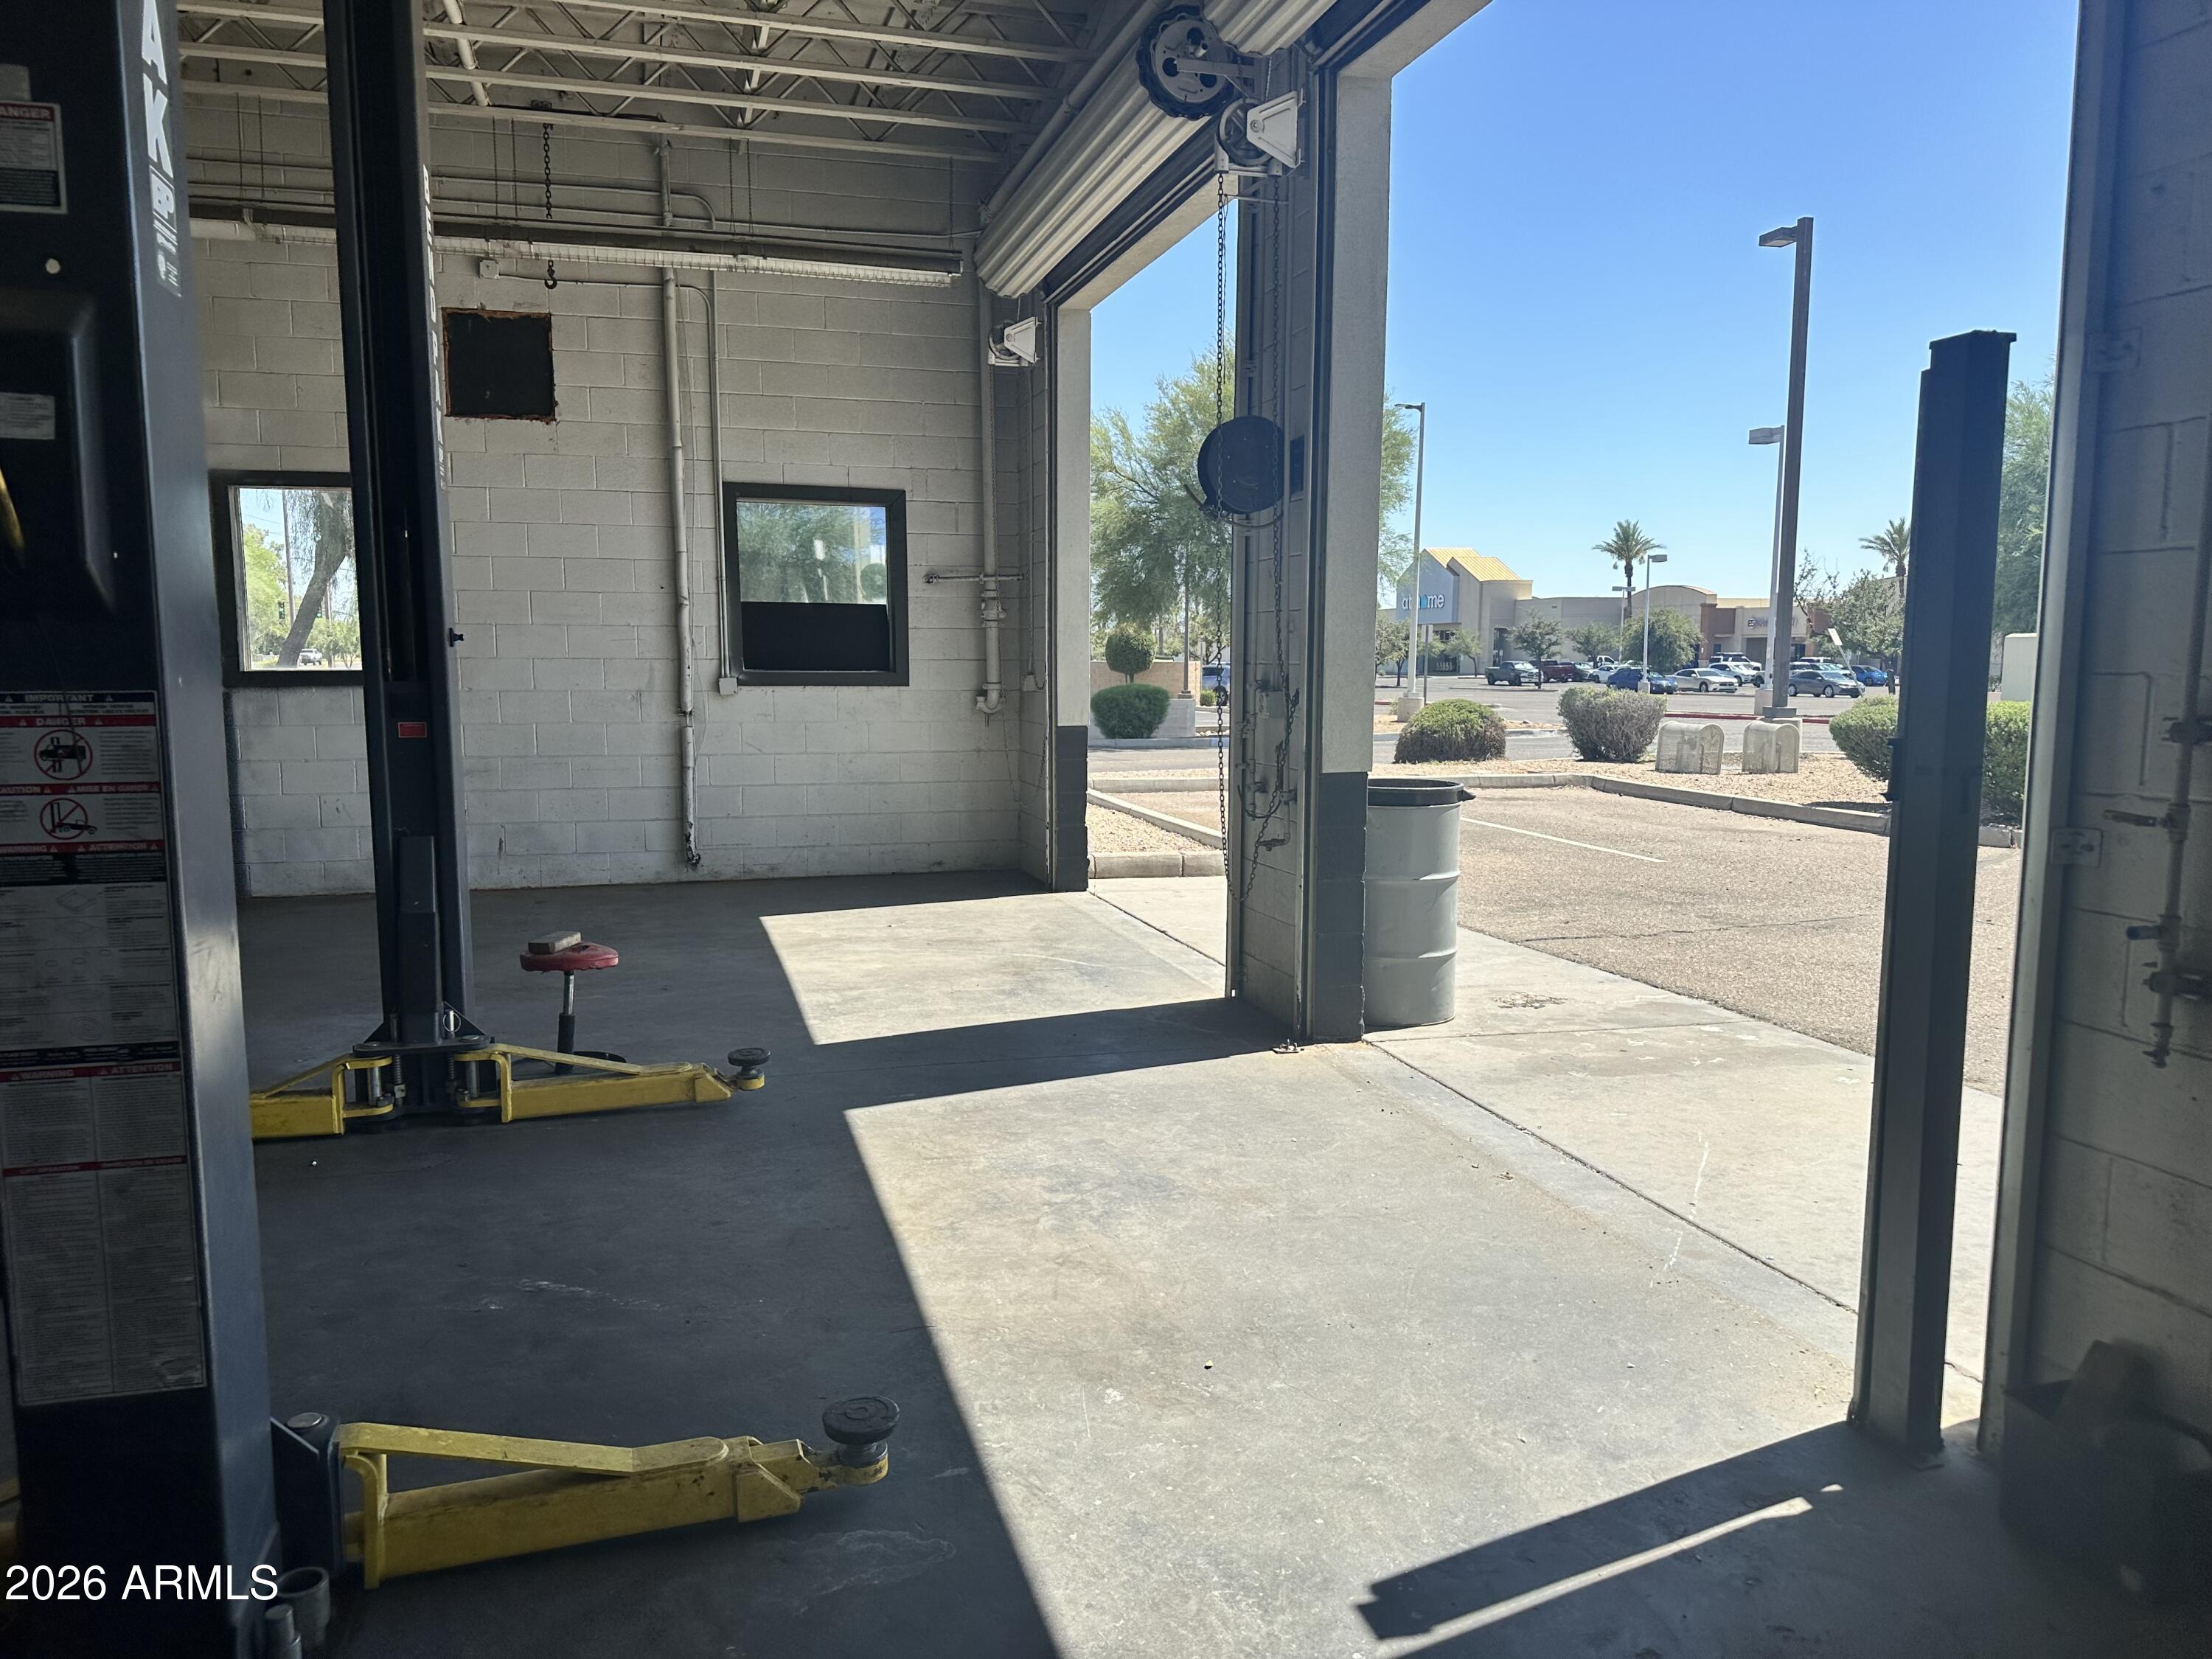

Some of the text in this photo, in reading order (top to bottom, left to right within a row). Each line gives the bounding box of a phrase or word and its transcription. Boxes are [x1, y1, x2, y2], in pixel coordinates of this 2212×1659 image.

[0, 105, 51, 120] ANGER
[24, 694, 94, 702] IMPORTANT
[35, 717, 86, 726] DANGER
[0, 785, 41, 794] AUTION
[111, 1063, 173, 1075] ATTENTION
[21, 1069, 74, 1080] WARNING
